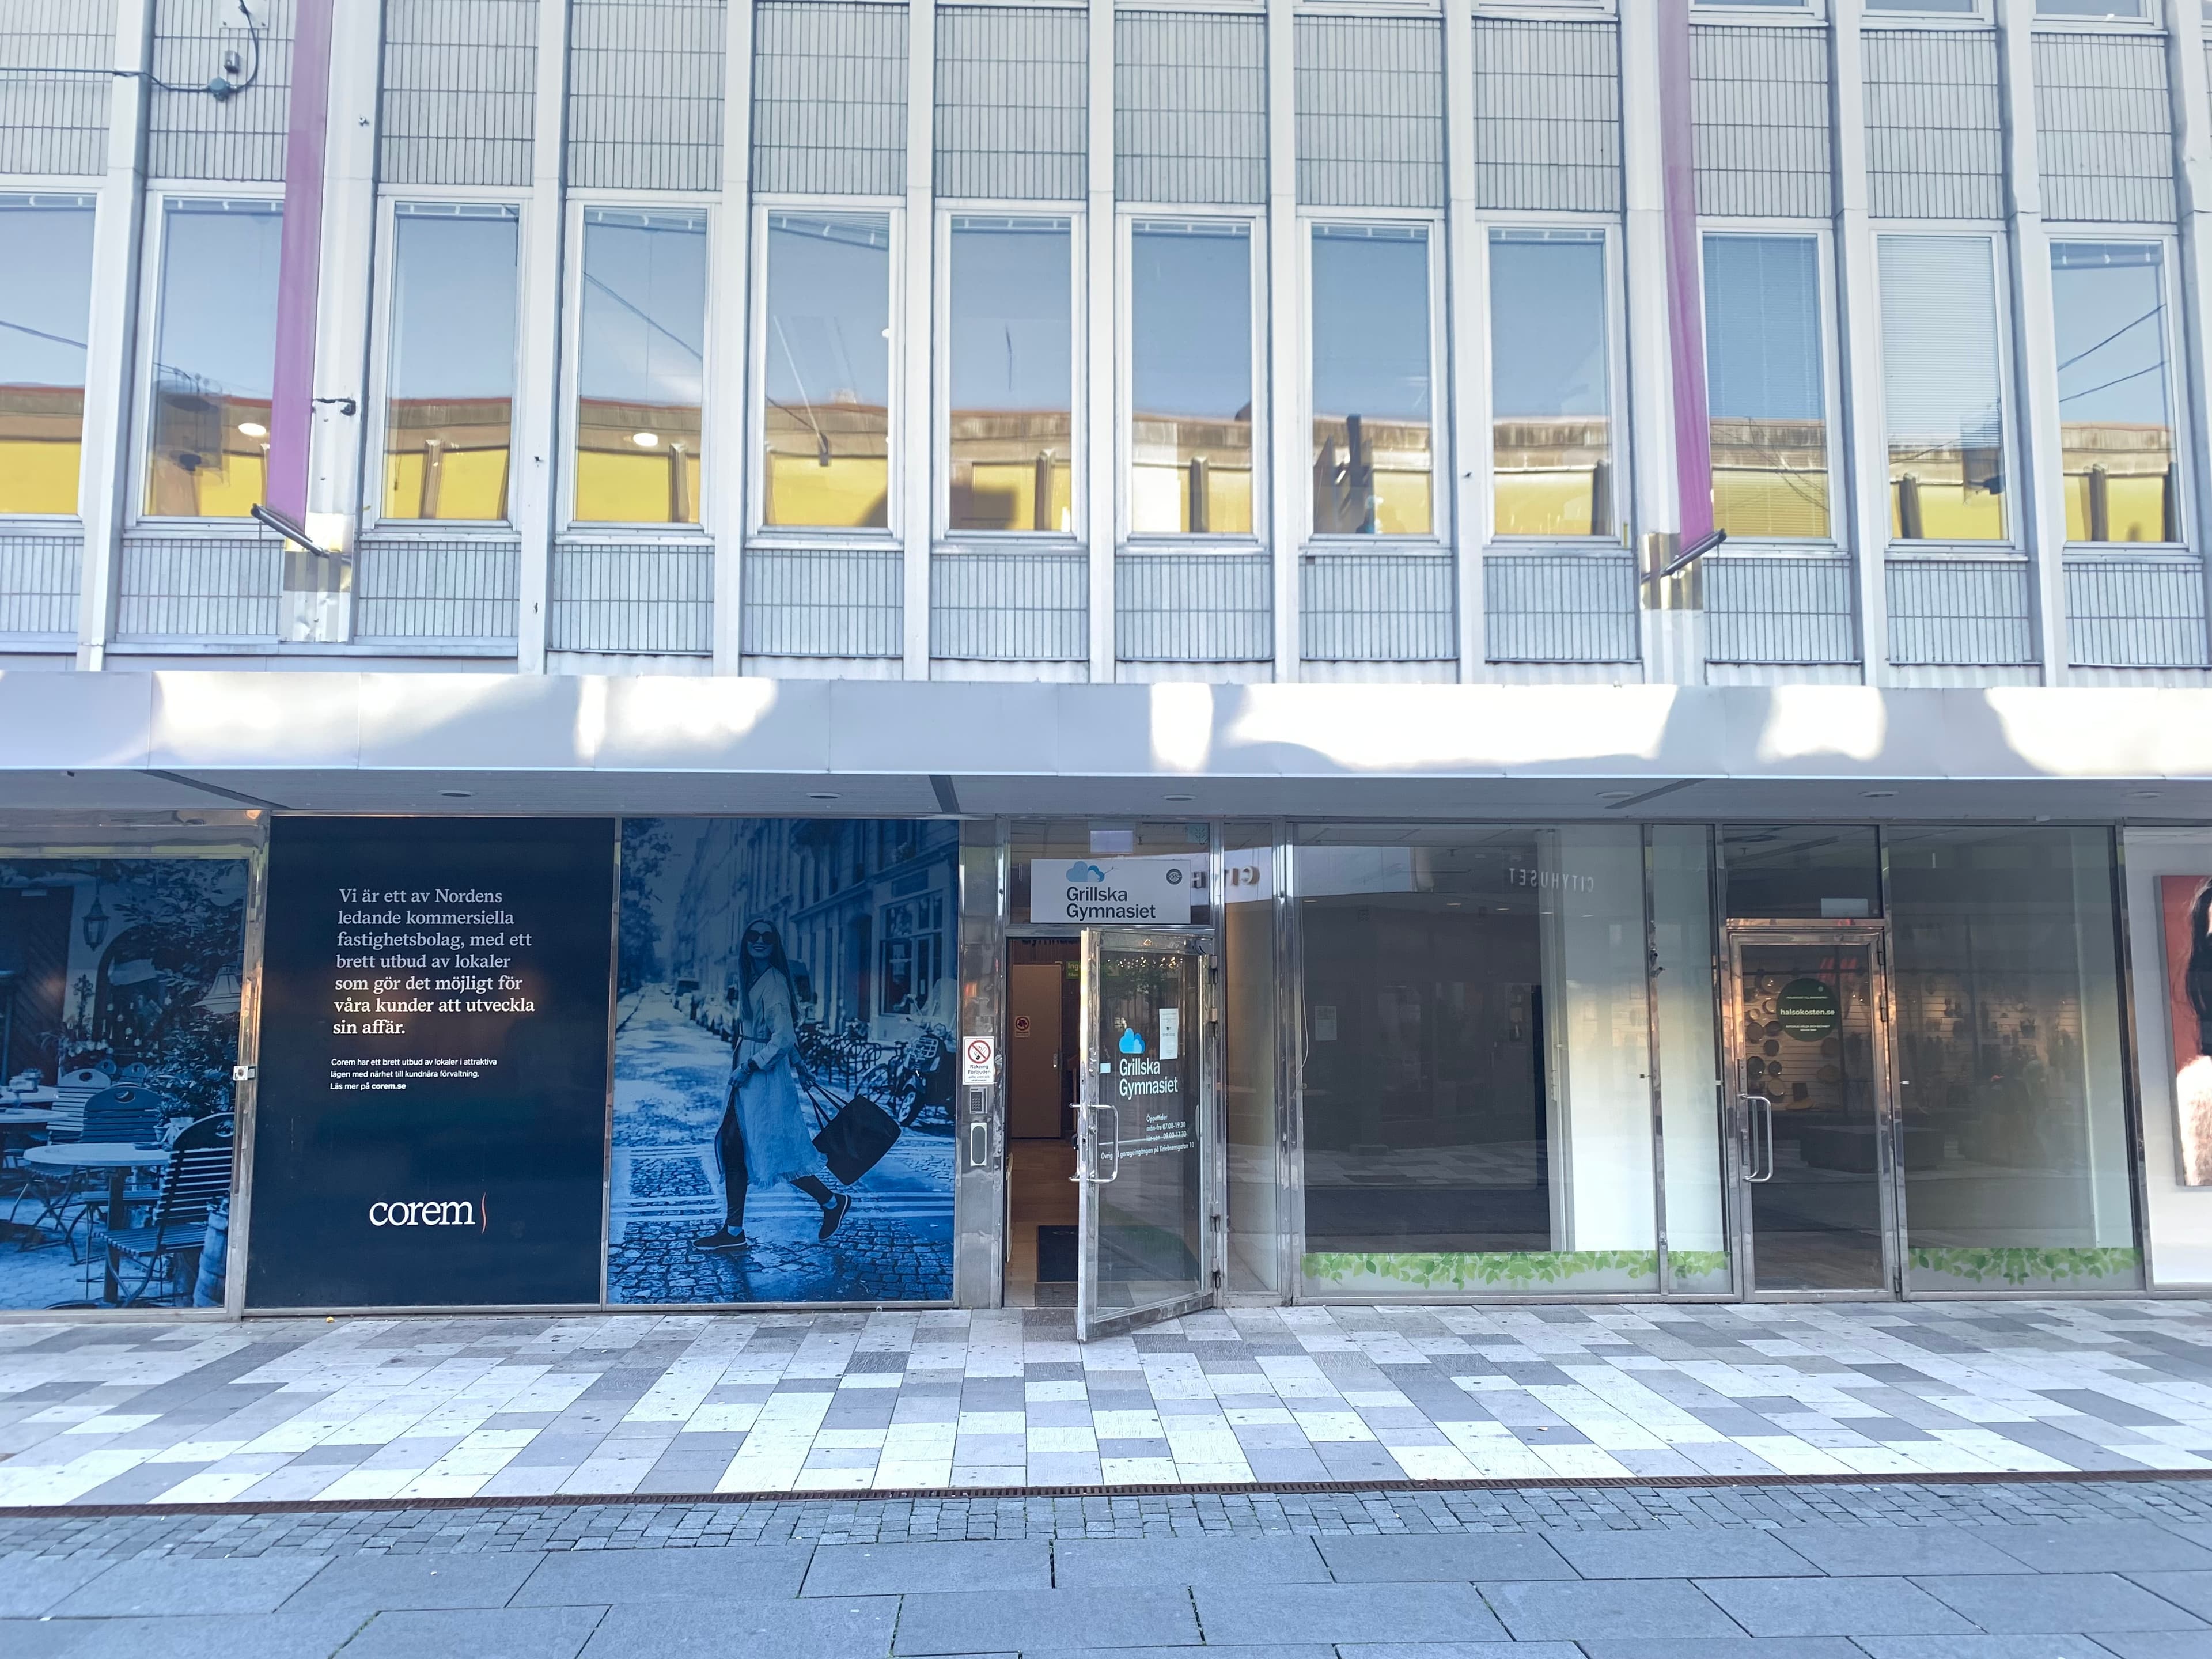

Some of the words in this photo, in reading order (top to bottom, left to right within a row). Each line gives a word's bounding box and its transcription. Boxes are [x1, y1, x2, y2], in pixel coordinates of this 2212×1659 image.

[339, 888, 358, 903] Vi
[362, 889, 380, 903] är
[384, 890, 407, 903] ett
[411, 892, 431, 903] av
[434, 888, 503, 903] Nordens
[1066, 886, 1128, 902] Grillska
[337, 910, 402, 925] ledande
[406, 910, 515, 925] kommersiella
[1066, 903, 1156, 921] Gymnasiet
[336, 931, 465, 950] fastighetsbolag,
[469, 931, 505, 946] med
[509, 933, 532, 946] ett
[336, 953, 376, 968] brett
[380, 953, 427, 968] utbud
[431, 957, 452, 968] av
[454, 953, 511, 968] lokaler
[335, 979, 369, 990] som
[373, 976, 402, 994] gör
[405, 975, 431, 990] det
[434, 975, 494, 994] möjligt
[498, 975, 523, 990] för
[333, 997, 372, 1012] våra
[375, 997, 435, 1012] kunder
[438, 999, 461, 1012] att
[465, 997, 536, 1012] utveckla
[332, 1019, 358, 1035] sin
[362, 1018, 406, 1035] affär.
[463, 1058, 497, 1066] attraktiva
[1119, 1058, 1161, 1077] Grillska
[330, 1070, 351, 1080] lägen
[395, 1070, 404, 1078] till
[404, 1070, 438, 1078] kundnära
[440, 1070, 480, 1079] förvaltning.
[360, 1082, 370, 1091] på
[1119, 1076, 1179, 1101] Gymnasiet
[369, 1201, 476, 1226] corem
